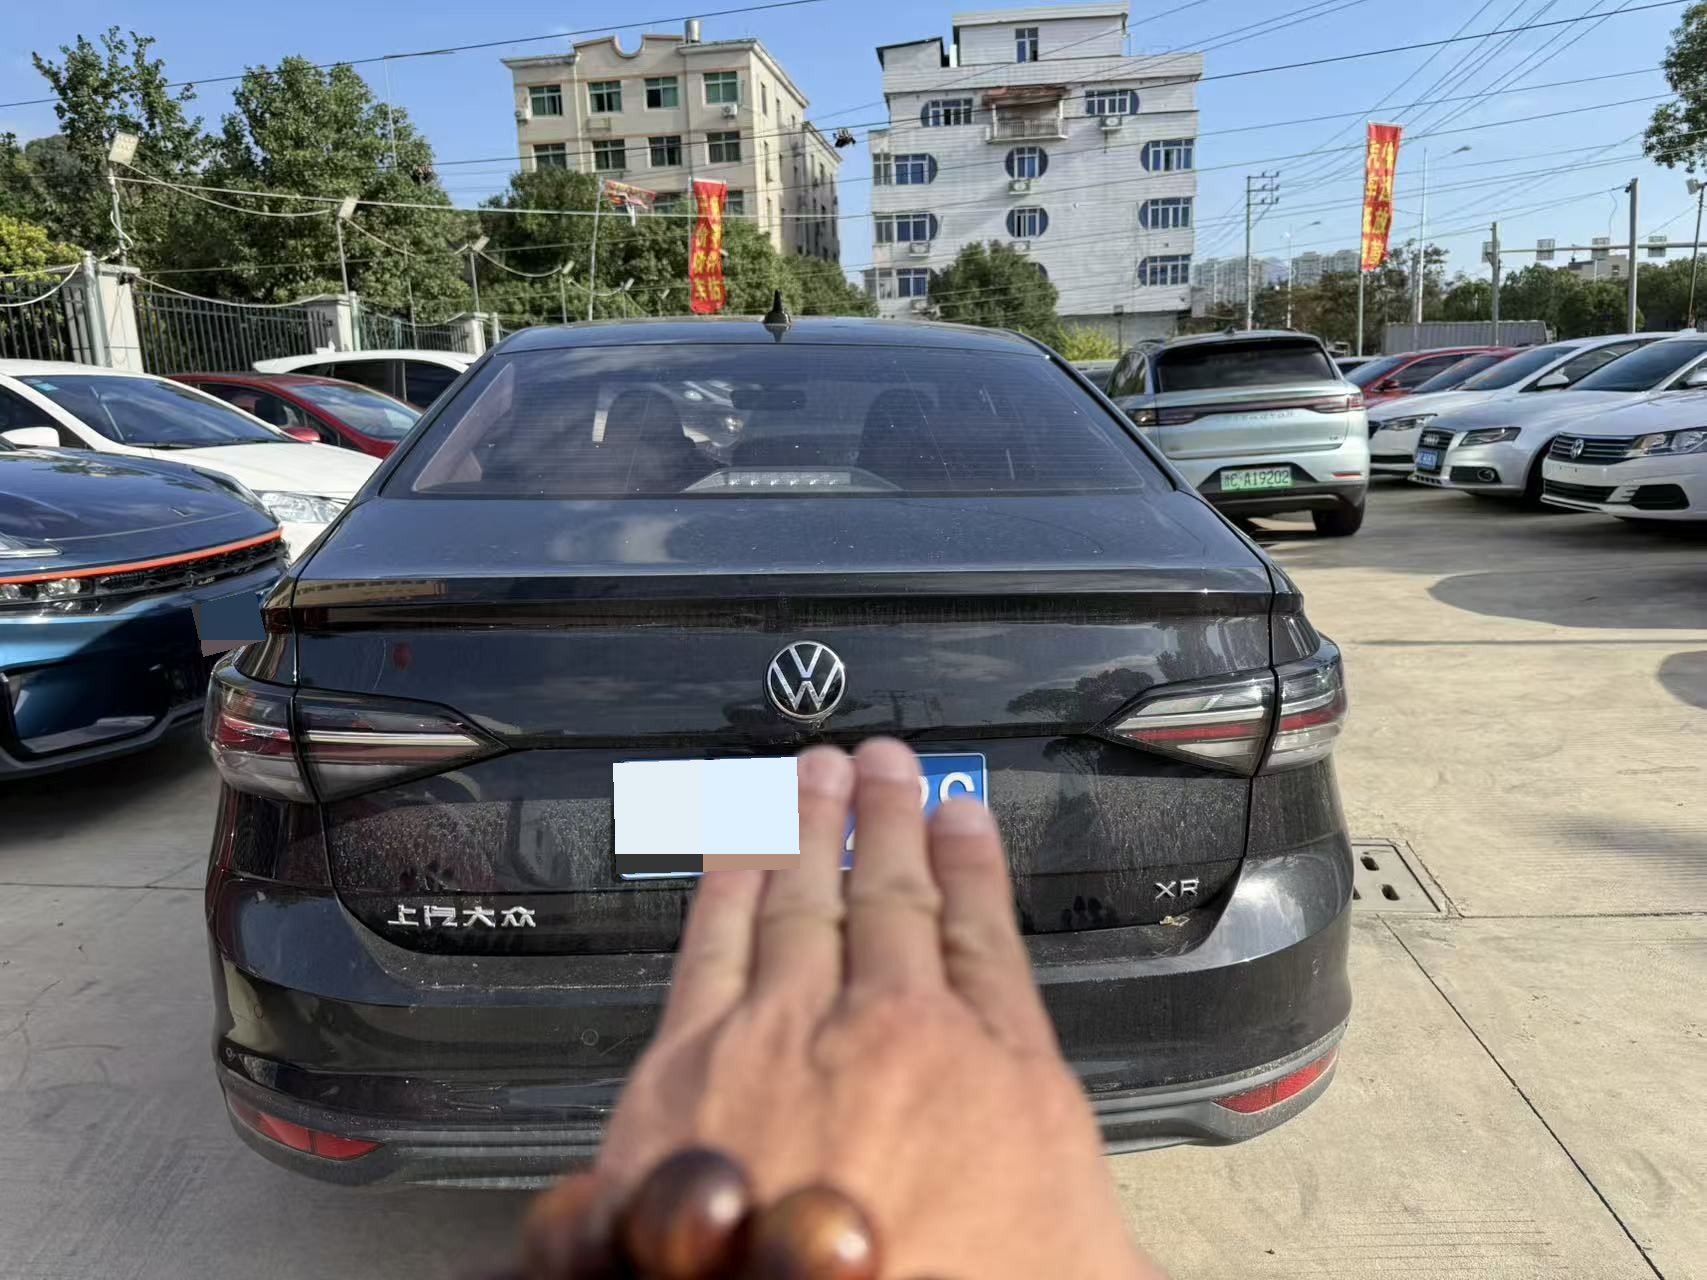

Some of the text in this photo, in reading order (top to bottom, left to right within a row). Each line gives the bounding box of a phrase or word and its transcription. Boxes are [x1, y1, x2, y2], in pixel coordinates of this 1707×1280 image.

[1154, 878, 1200, 901] XR
[387, 904, 537, 929] 上汽大众
